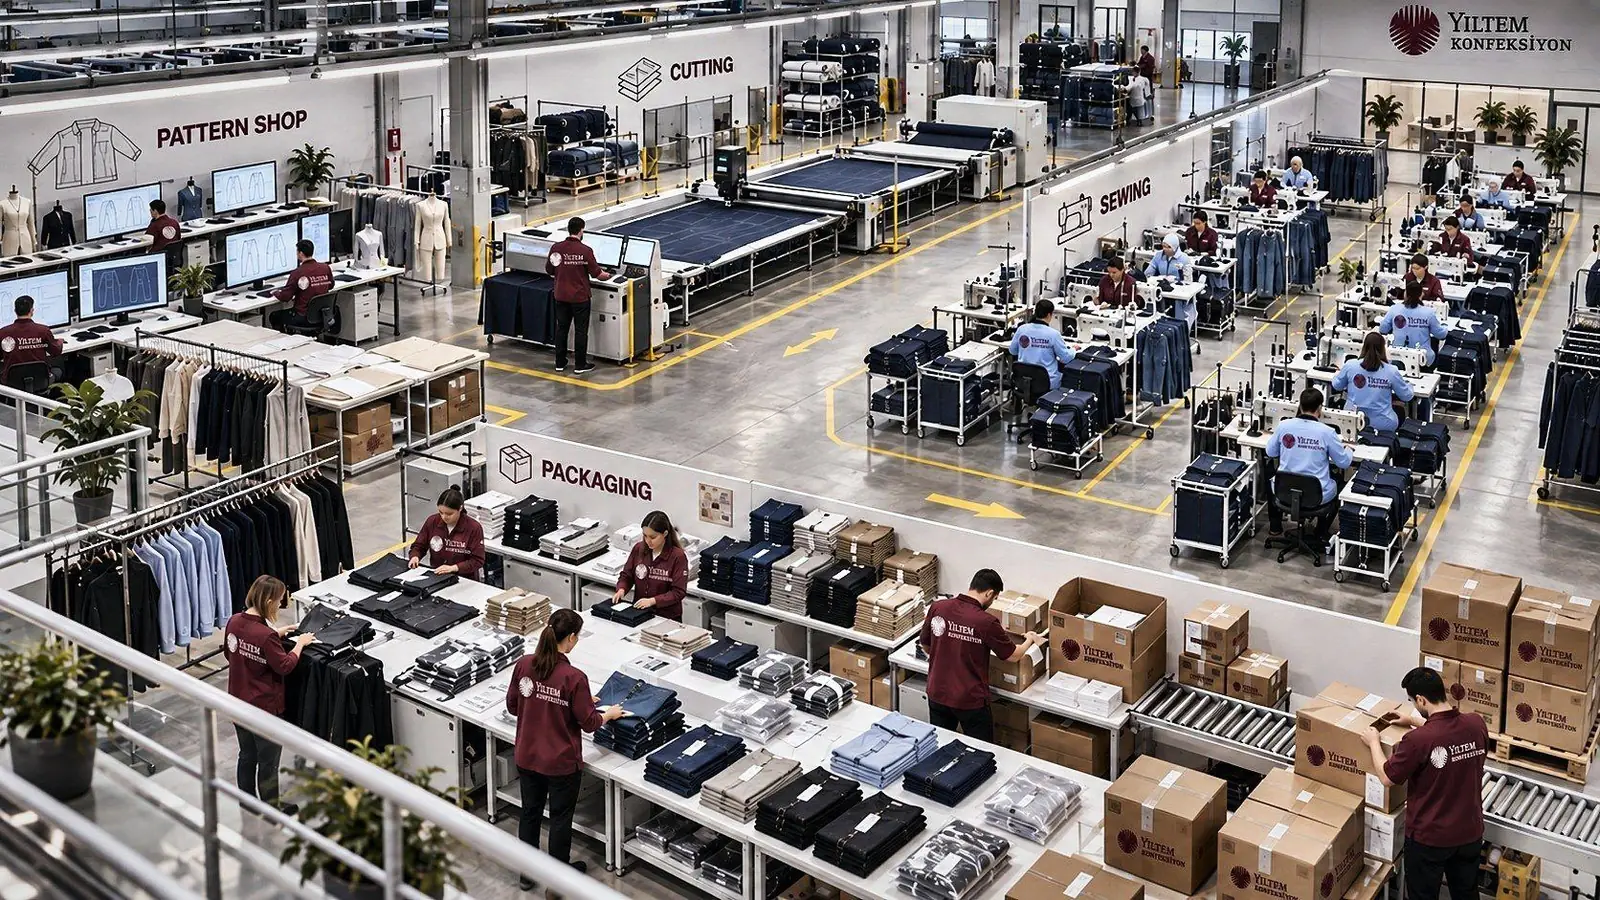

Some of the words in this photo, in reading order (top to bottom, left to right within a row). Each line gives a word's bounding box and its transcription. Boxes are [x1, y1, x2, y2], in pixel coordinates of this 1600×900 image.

[1447, 12, 1529, 33] YILTEM
[1451, 35, 1572, 51] KONFEKSİYON
[670, 56, 734, 81] CUTTING
[157, 117, 249, 149] PATTERN
[254, 109, 308, 134] SHOP
[1100, 176, 1151, 215] SEWING
[541, 459, 652, 501] PACKAGING
[1452, 622, 1489, 639] YILTEM
[1082, 644, 1114, 661] YILTEM
[1539, 645, 1573, 661] YILTEM
[1535, 707, 1568, 724] YILTEM
[1328, 751, 1358, 768] YILTEM
[1140, 836, 1176, 858] YILTEM
[1253, 872, 1288, 892] YILTEM
